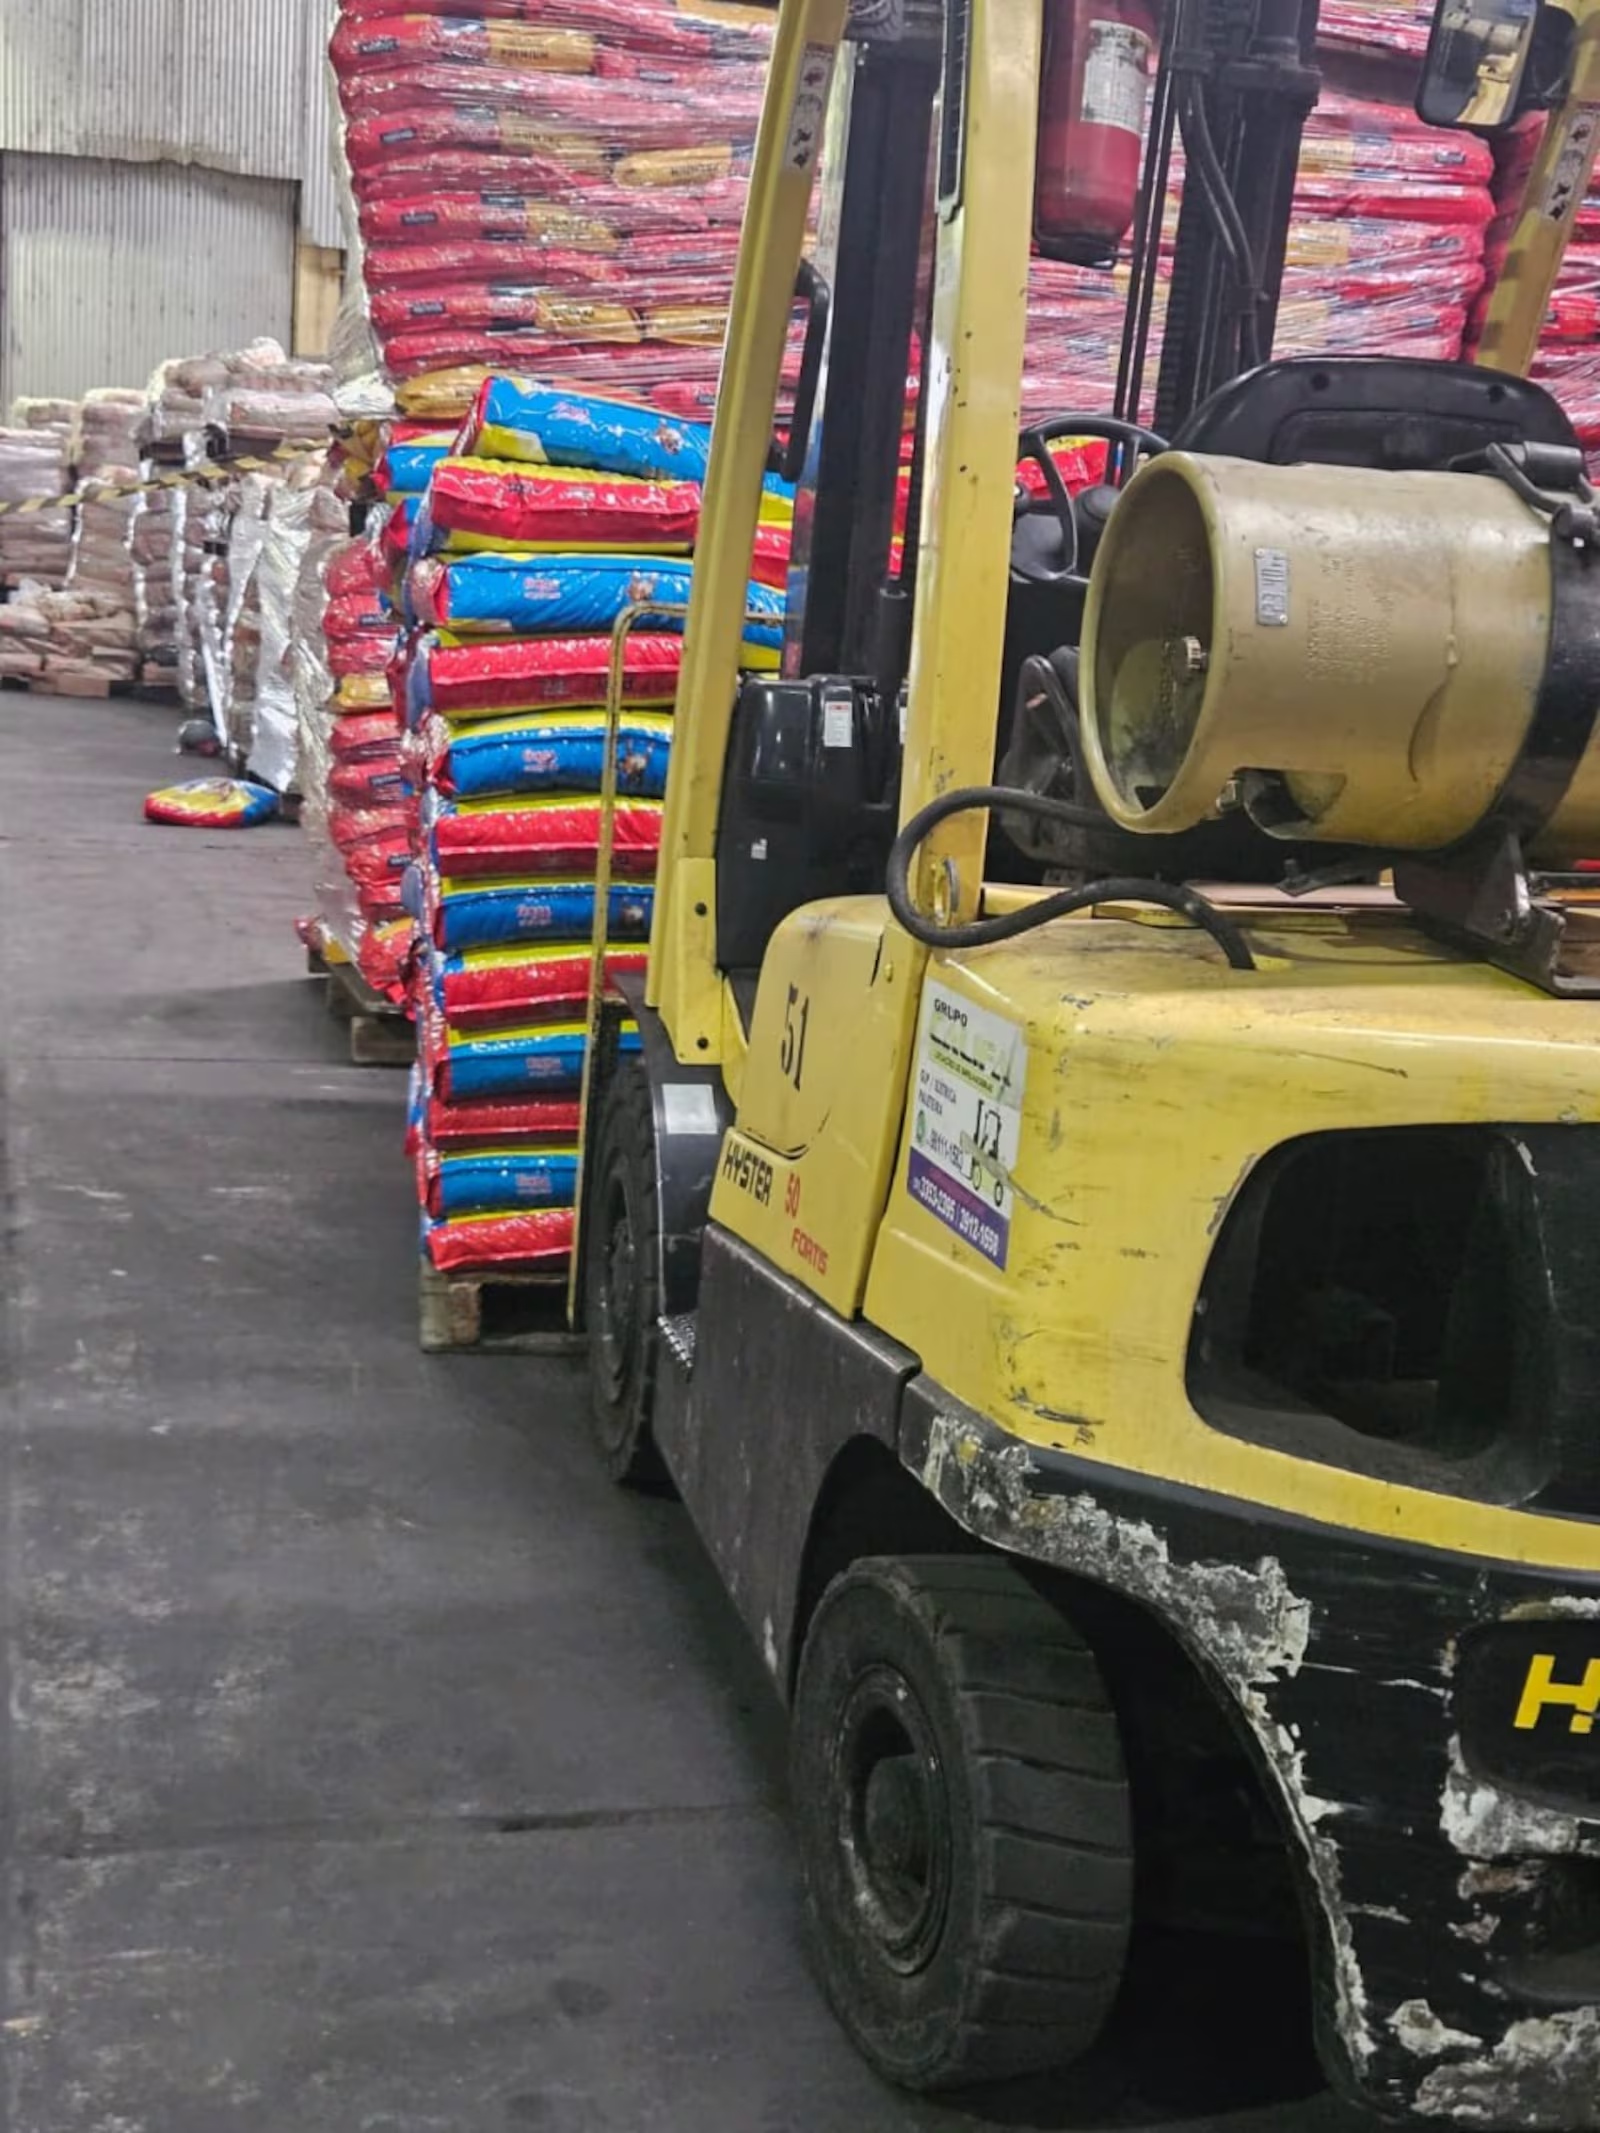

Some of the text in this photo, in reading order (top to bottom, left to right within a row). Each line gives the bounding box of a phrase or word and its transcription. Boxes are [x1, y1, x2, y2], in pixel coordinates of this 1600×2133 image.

[781, 982, 809, 1092] 51
[722, 1141, 774, 1207] HYSTER
[785, 1173, 801, 1219] 50
[792, 1228, 829, 1276] FORTIS
